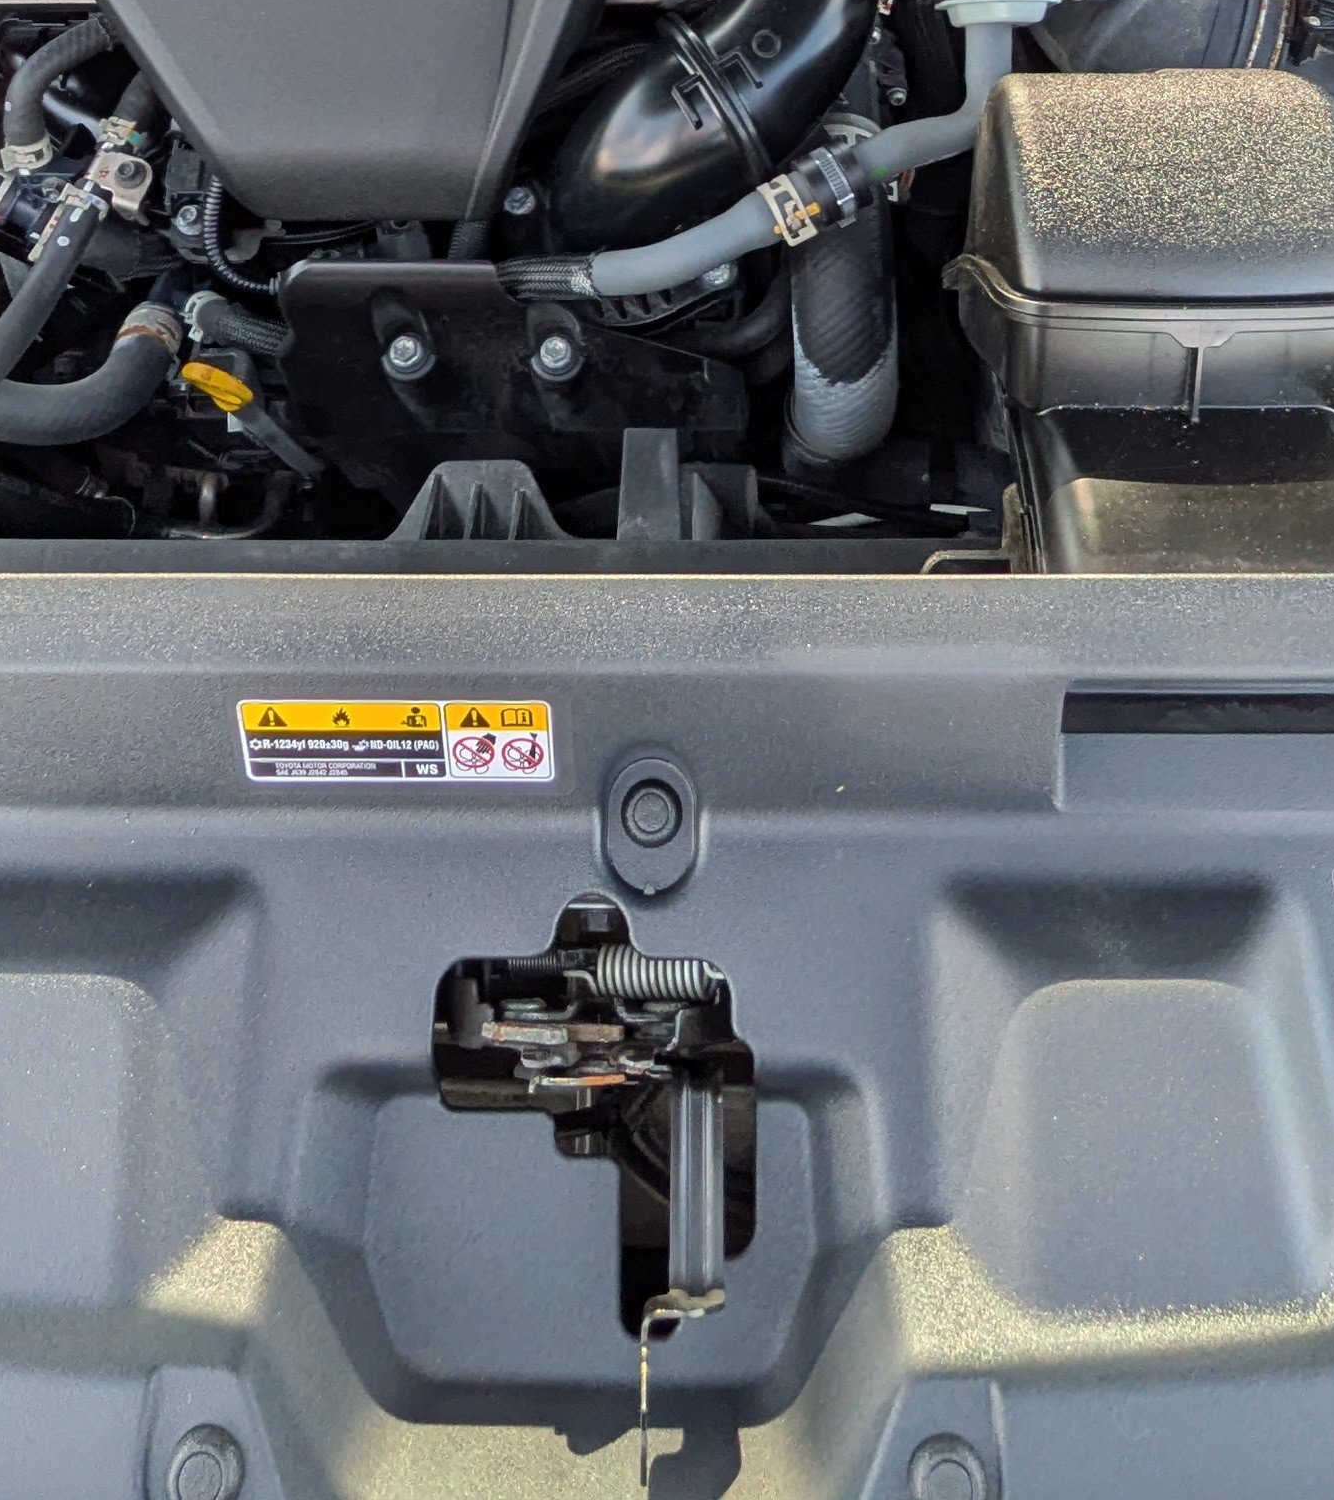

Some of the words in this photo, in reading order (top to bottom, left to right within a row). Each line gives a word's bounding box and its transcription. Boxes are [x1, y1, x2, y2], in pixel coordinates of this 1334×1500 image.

[262, 739, 306, 751] R-1234yf
[308, 739, 349, 751] 920±30g
[413, 740, 440, 752] (PAG)
[328, 762, 377, 770] CORPORATION
[415, 763, 439, 775] WS
